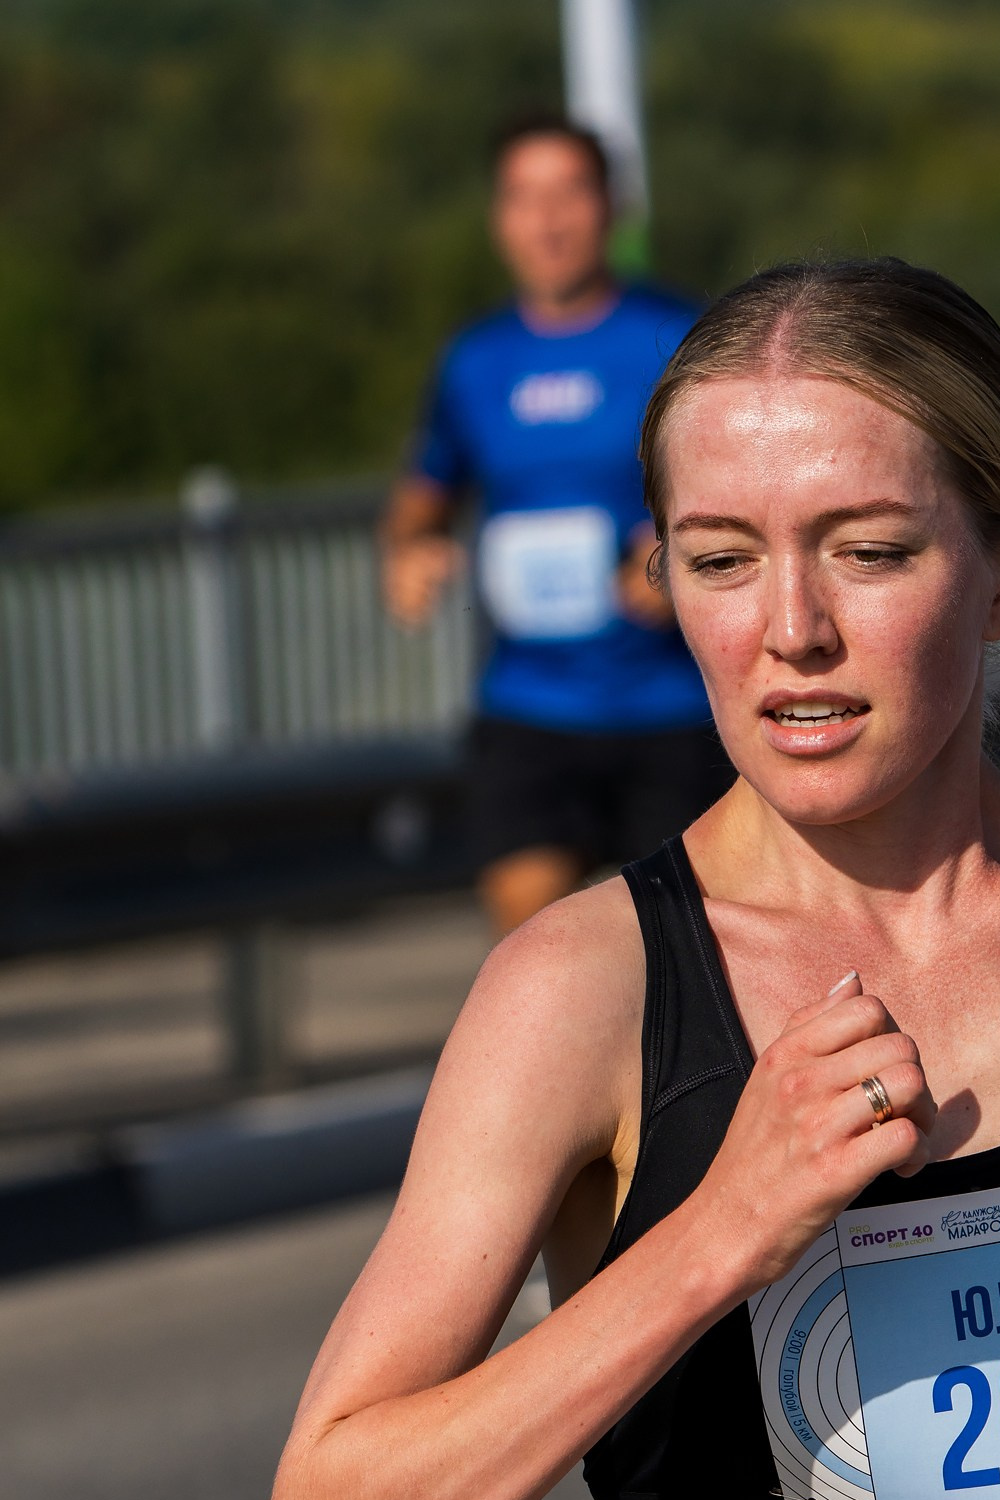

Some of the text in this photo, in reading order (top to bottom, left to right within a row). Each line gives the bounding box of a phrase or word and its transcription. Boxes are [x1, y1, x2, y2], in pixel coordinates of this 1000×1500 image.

[849, 1225, 871, 1234] PRO
[851, 1224, 933, 1248] СПОРТ 40
[780, 1369, 798, 1412] голубой
[793, 1419, 806, 1427] 5
